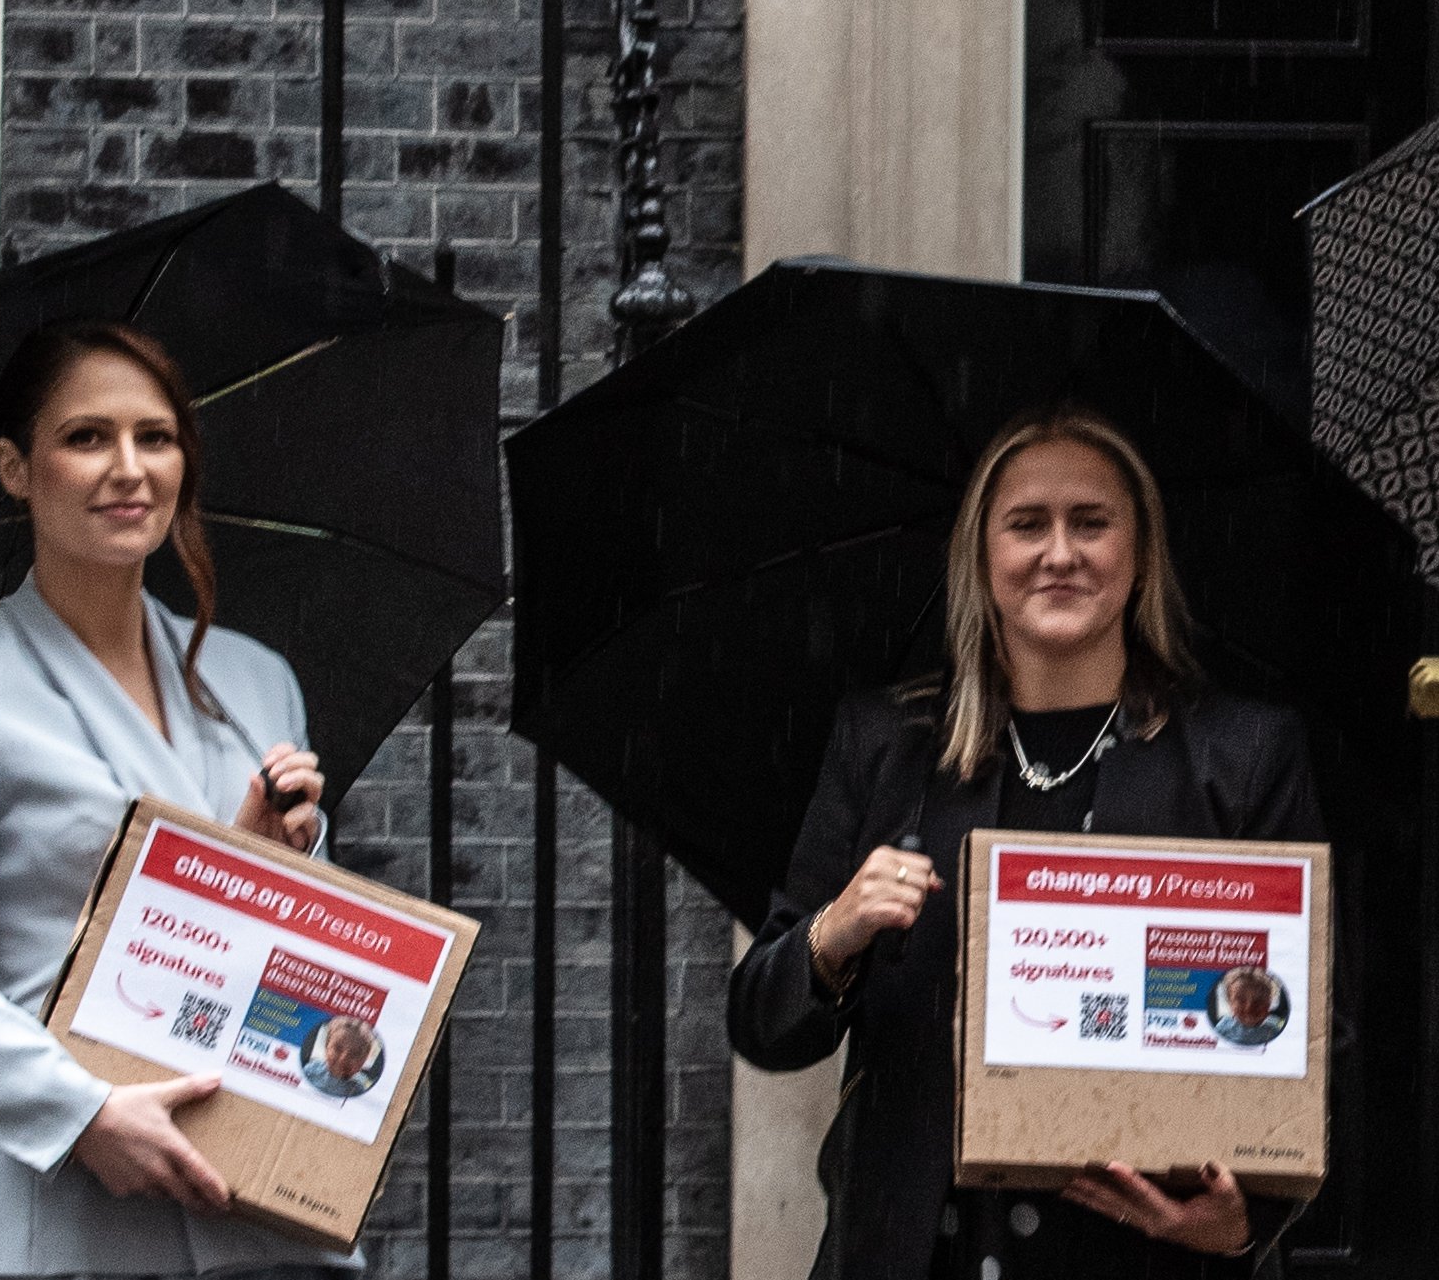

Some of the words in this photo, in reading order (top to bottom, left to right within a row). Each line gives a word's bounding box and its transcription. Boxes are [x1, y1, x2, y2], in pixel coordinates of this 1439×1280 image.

[139, 905, 233, 954] 120,500+
[1011, 927, 1110, 950] 120,500+
[1147, 928, 1208, 947] Preston
[124, 938, 227, 989] signatures
[1010, 959, 1114, 983] signatures
[1147, 945, 1216, 962] deserved
[270, 949, 329, 985] Preston
[328, 969, 376, 1002] Davey
[264, 967, 331, 1004] deserved
[330, 988, 379, 1021] better
